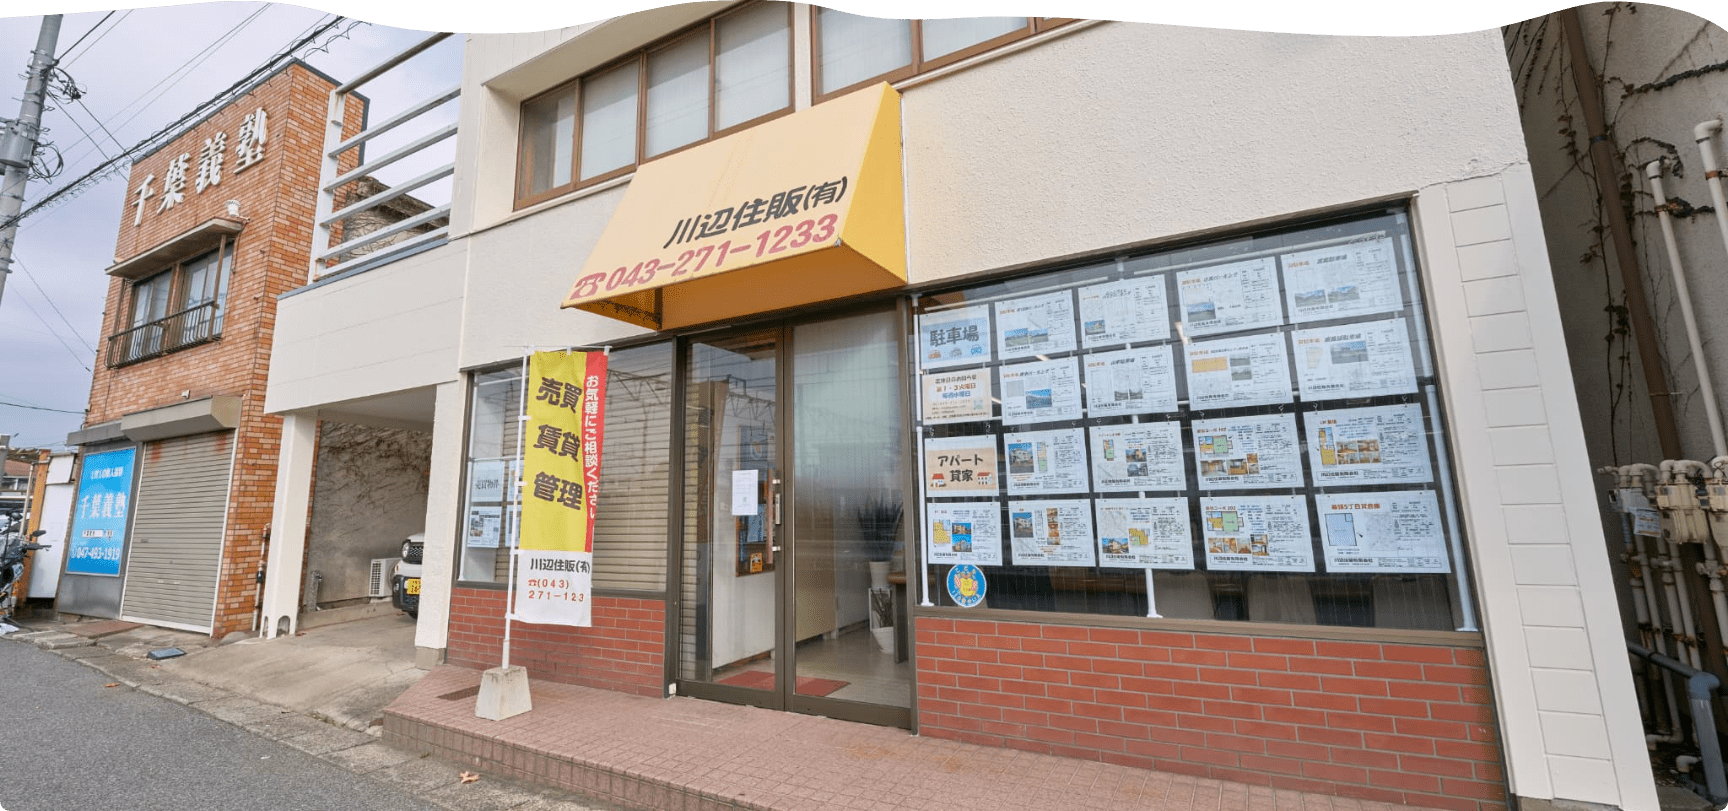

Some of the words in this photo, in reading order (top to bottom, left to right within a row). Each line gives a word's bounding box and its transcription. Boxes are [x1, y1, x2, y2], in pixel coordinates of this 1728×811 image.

[132, 107, 267, 227] 千葉義塾
[663, 176, 848, 249] 川辺住販(有)
[606, 213, 838, 292] 043-271-1233
[929, 325, 980, 348] 駐車場
[536, 376, 583, 414] 売買
[533, 424, 581, 462] 賃貸
[937, 454, 984, 467] アパート
[533, 471, 583, 510] 管理
[949, 469, 973, 482] 貸家
[81, 491, 126, 519] 千葉義塾
[530, 558, 591, 574] 川辺住販(有)
